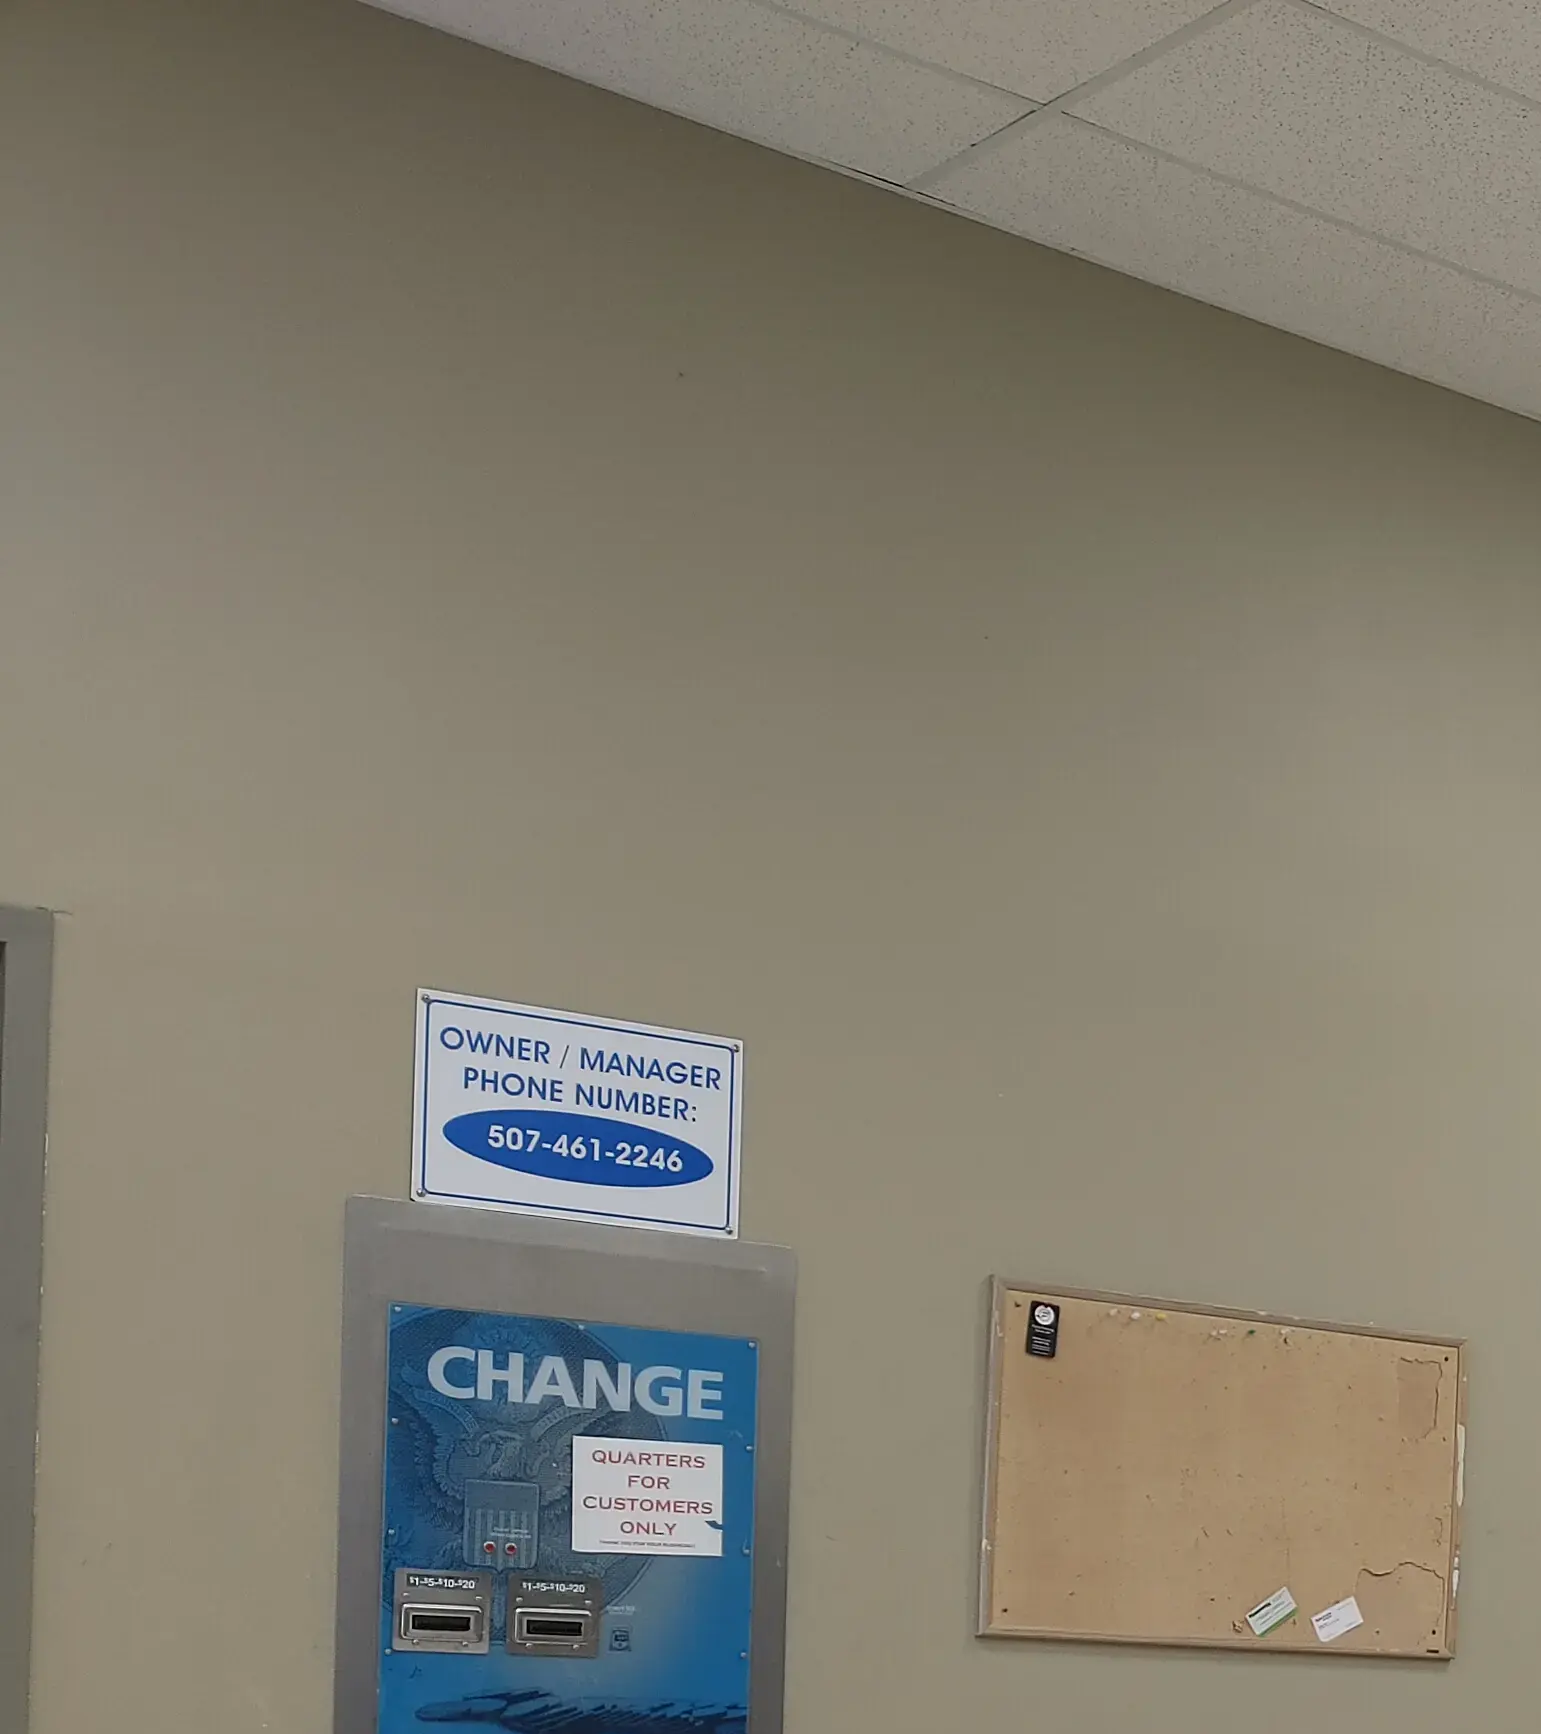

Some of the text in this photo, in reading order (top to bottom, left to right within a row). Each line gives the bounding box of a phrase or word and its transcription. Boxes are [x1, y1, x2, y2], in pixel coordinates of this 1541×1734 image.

[440, 1027, 550, 1064] OWNER
[580, 1048, 721, 1090] MANAGER
[464, 1067, 697, 1122] PHONE NUMBER:
[488, 1125, 683, 1172] 507-461-2246
[427, 1346, 724, 1421] CHANGE
[592, 1450, 705, 1468] QUARTERS
[628, 1476, 670, 1489] FOR
[583, 1496, 713, 1514] CUSTOMERS
[620, 1521, 676, 1535] ONLY
